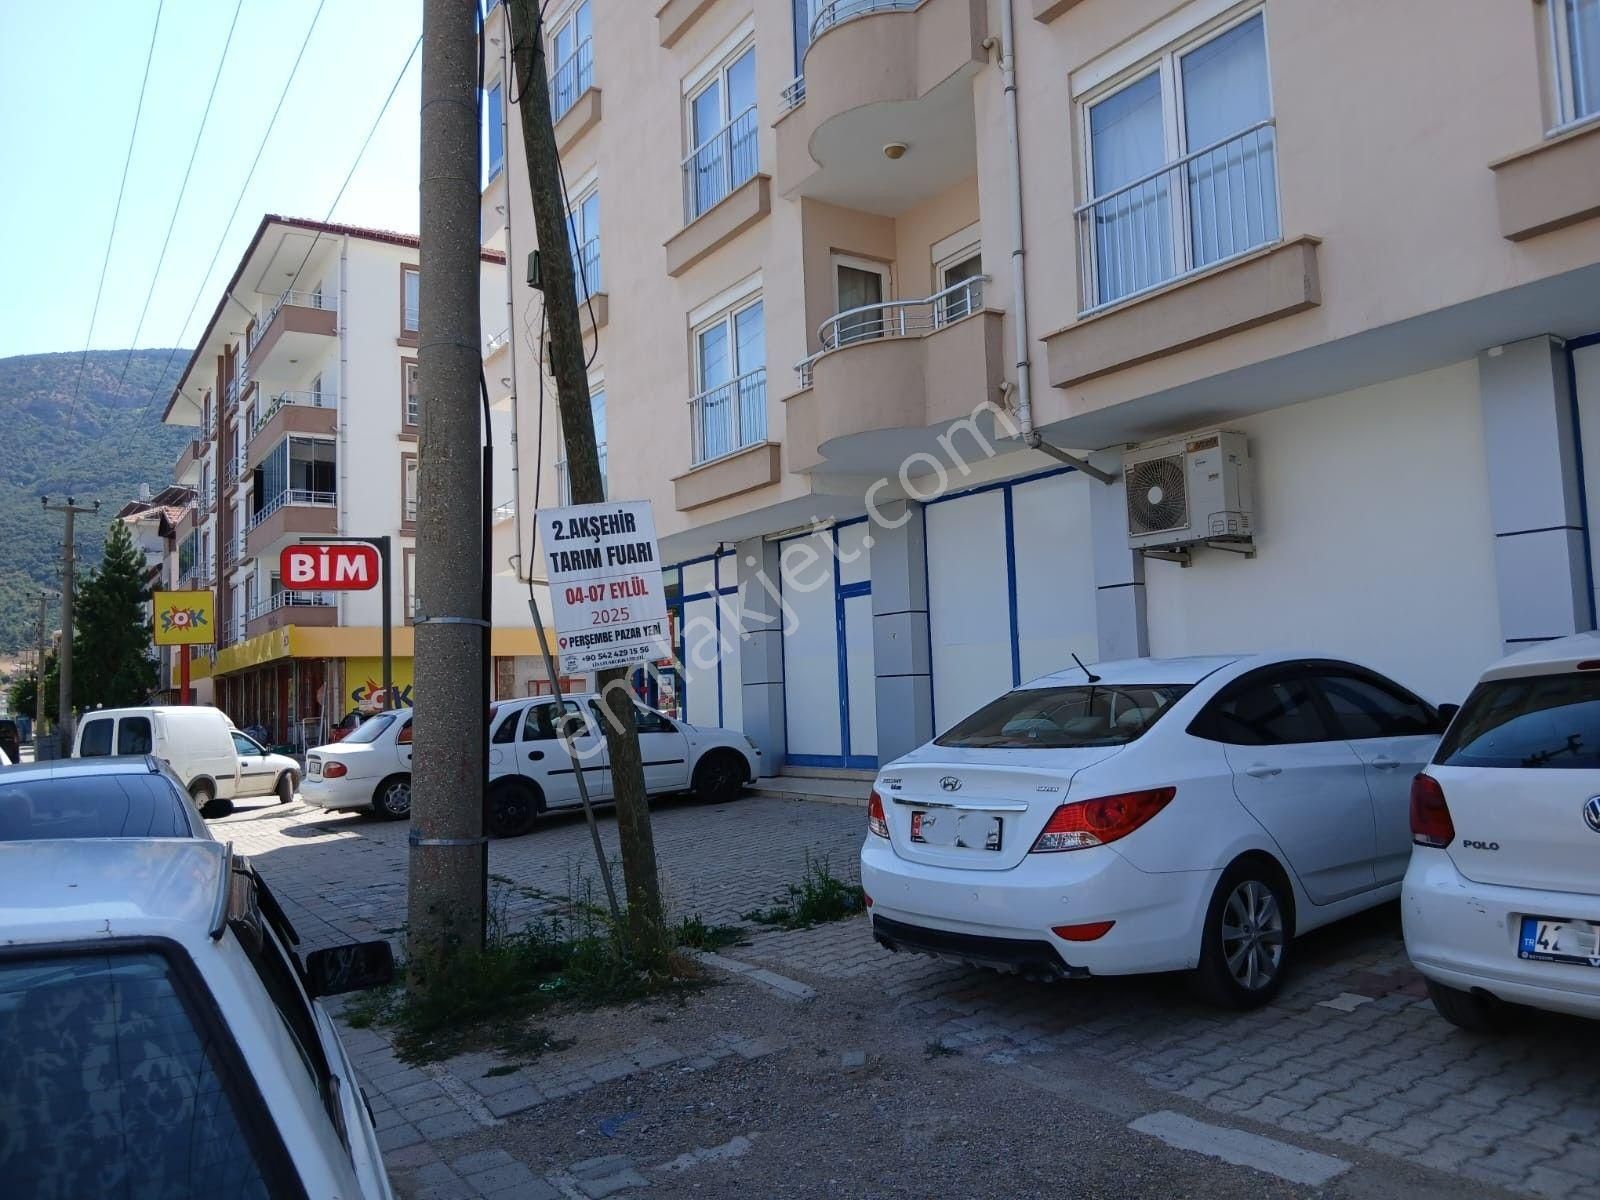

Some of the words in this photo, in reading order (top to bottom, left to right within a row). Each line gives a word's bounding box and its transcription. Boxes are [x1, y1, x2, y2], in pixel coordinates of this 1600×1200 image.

[552, 510, 636, 543] 2.AKŞEHİR
[290, 547, 368, 582] BİM
[550, 548, 603, 573] TARIM
[606, 542, 654, 567] FUARI
[565, 584, 605, 605] 04-07
[610, 576, 649, 600] EYLÜL
[160, 607, 208, 633] ŞOK
[591, 607, 630, 625] 2025
[569, 630, 614, 649] PERŞEMBE
[615, 627, 642, 641] PAZAR
[643, 622, 662, 637] YERİ
[597, 651, 613, 660] 542
[1463, 839, 1500, 851] POLO
